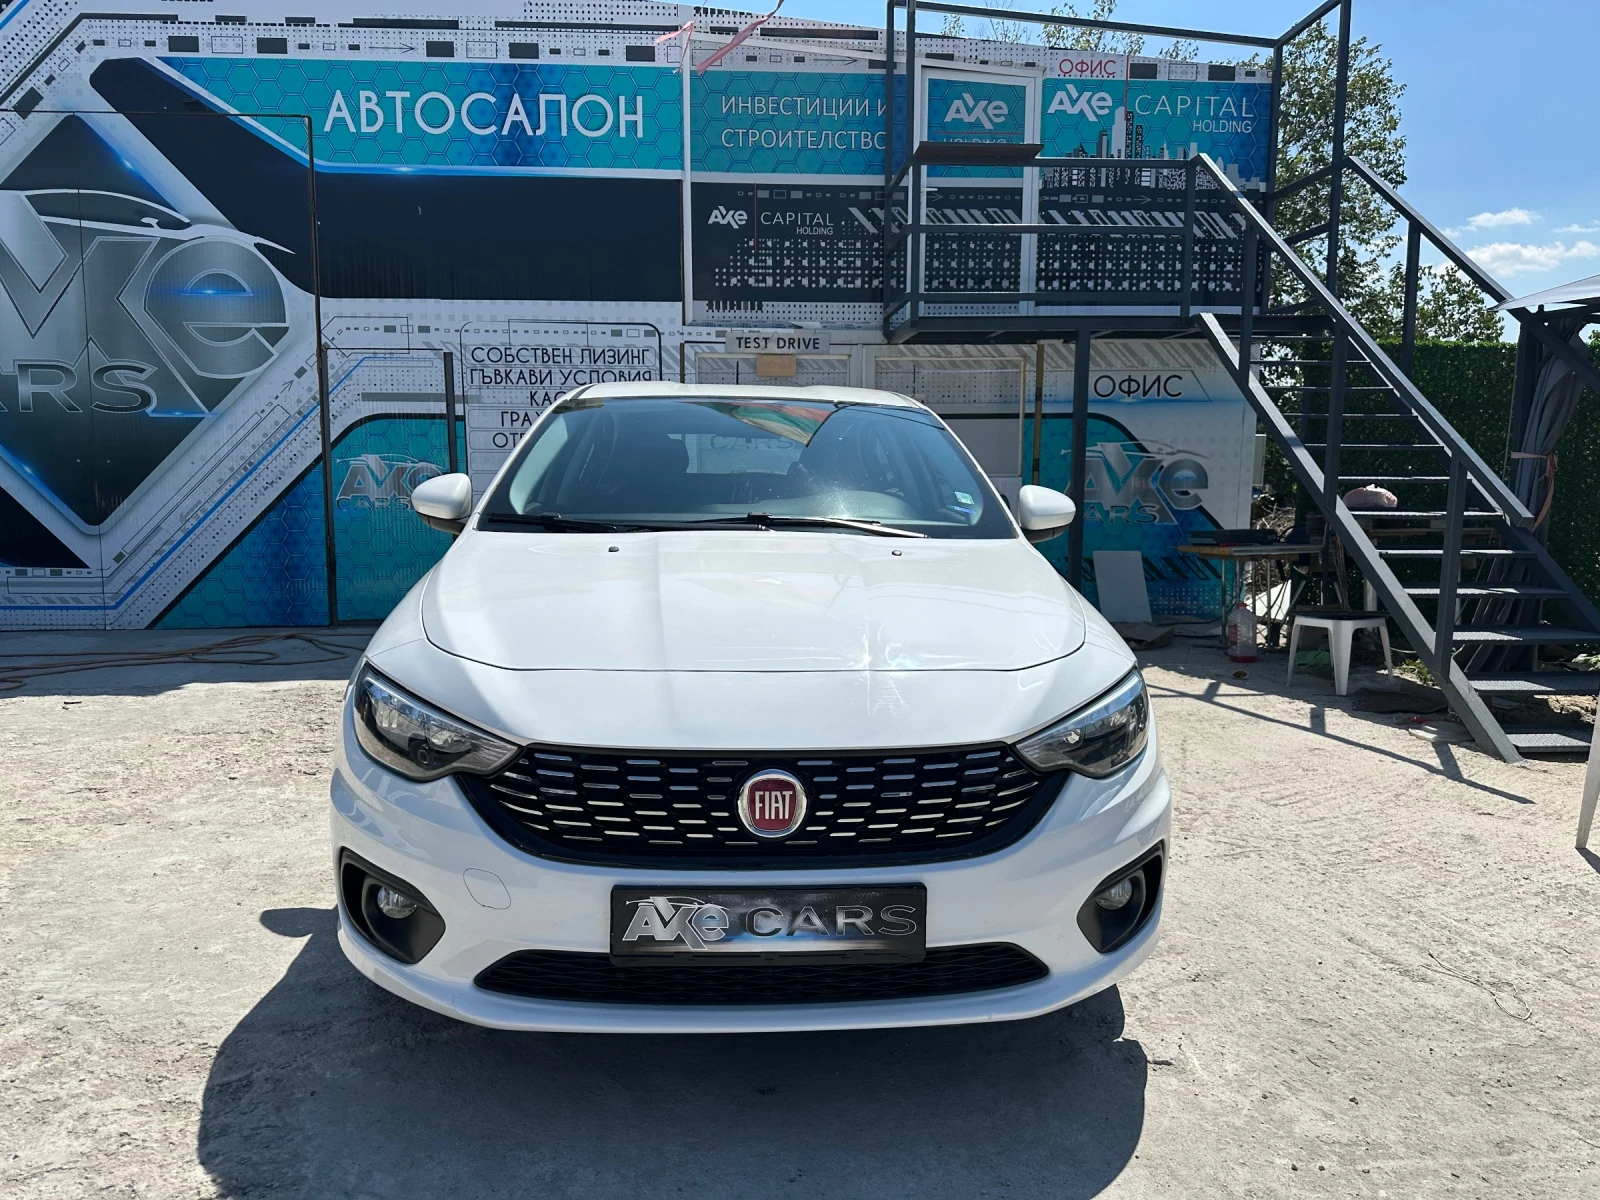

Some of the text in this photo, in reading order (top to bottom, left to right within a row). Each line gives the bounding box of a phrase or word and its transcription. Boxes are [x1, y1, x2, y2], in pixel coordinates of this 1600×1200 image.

[1058, 57, 1117, 77] ОФИС
[323, 89, 643, 138] АВТОСАЛОН
[721, 95, 869, 120] ИНВЕСТИЦИИ
[1135, 94, 1254, 118] CAPITAL
[1193, 119, 1252, 134] HOLDING
[760, 212, 834, 226] CAPITAL
[796, 226, 834, 236] HOLDING
[736, 336, 820, 350] TEST DRIVE
[471, 346, 650, 365] СОБСТВЕН ЛИЗИНГ
[470, 368, 652, 386] ГЪВКАВИ УСЛОВИЯ
[1093, 374, 1183, 399] ОФИС
[336, 496, 412, 511] CARS
[1083, 505, 1159, 524] ARS
[754, 790, 793, 820] FIAT
[745, 904, 918, 937] CARS
